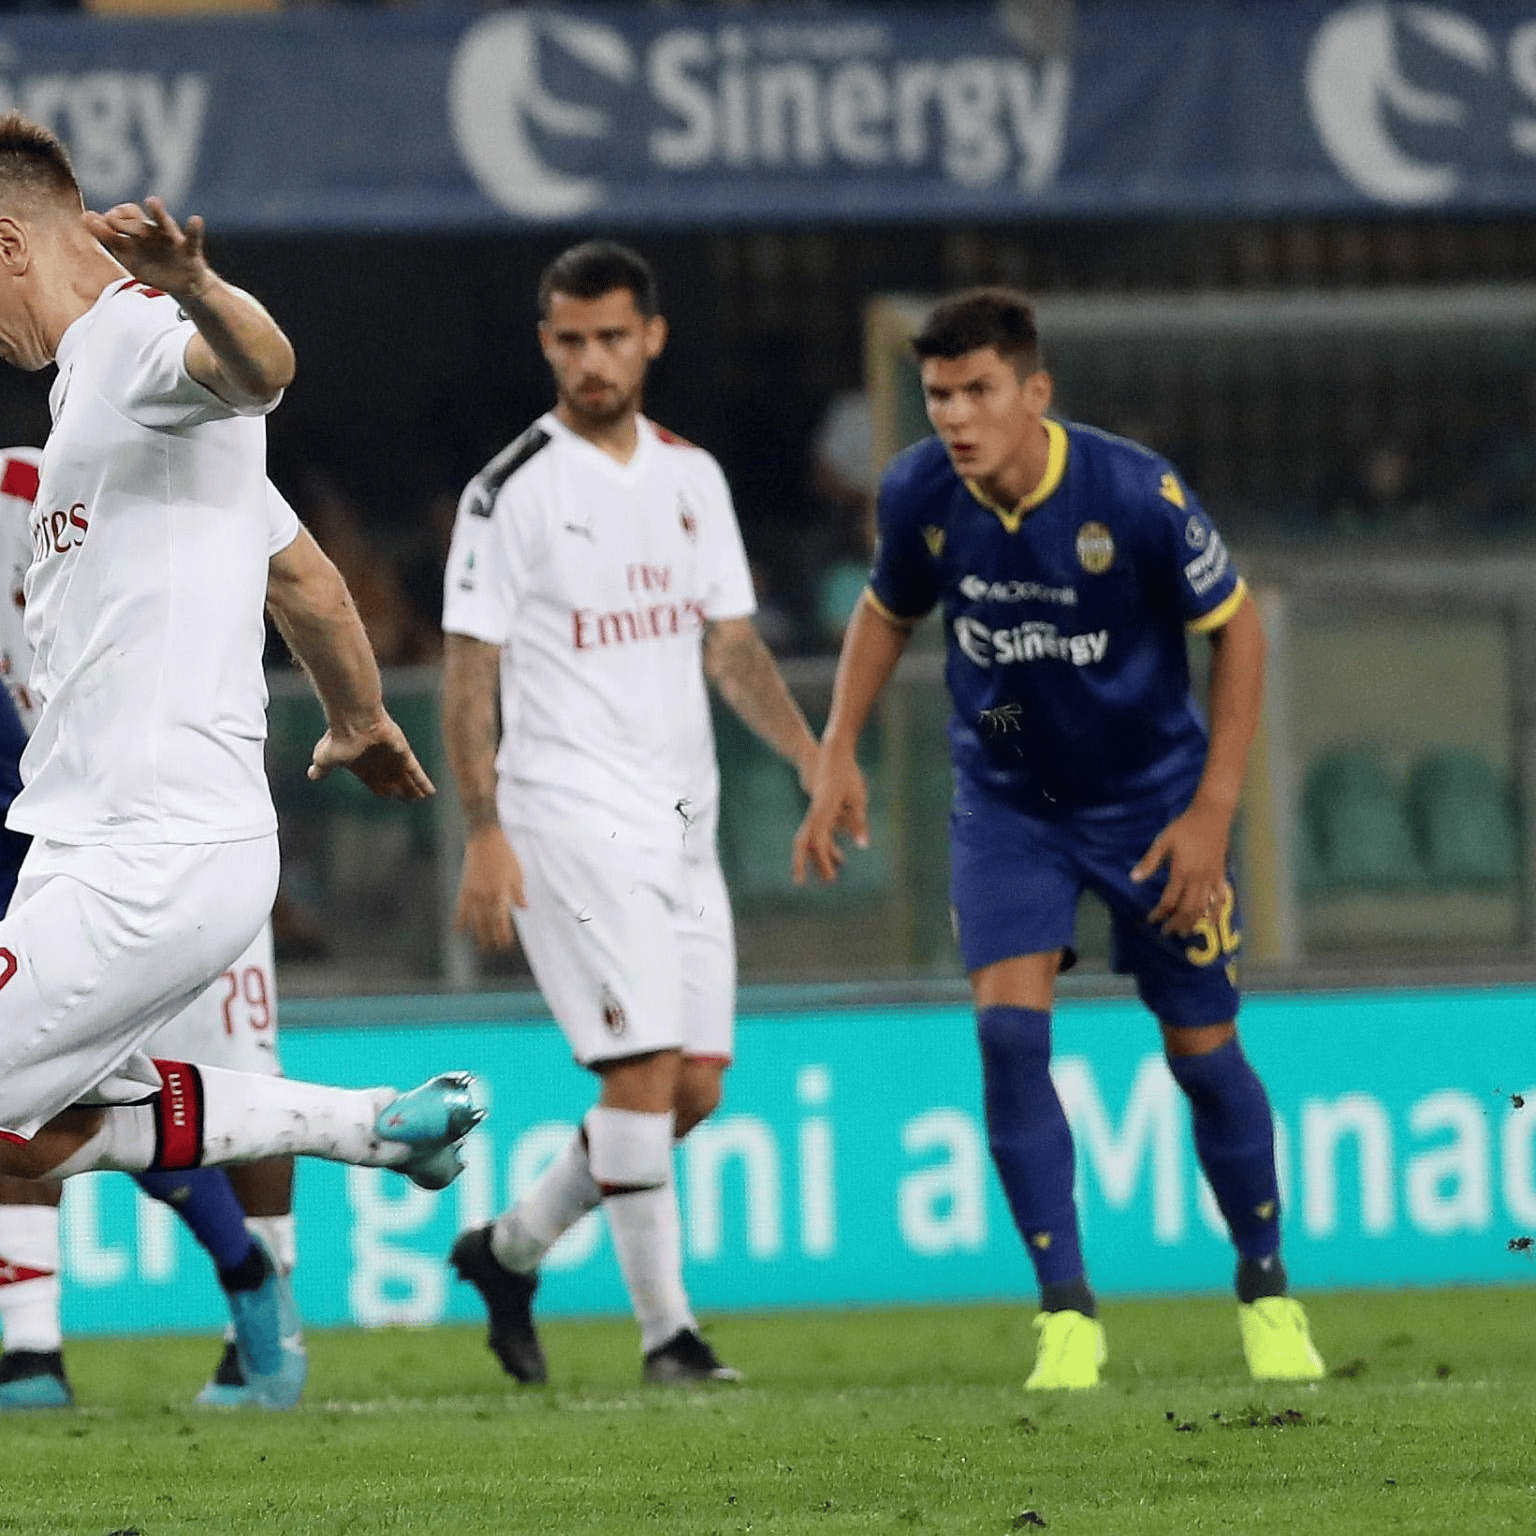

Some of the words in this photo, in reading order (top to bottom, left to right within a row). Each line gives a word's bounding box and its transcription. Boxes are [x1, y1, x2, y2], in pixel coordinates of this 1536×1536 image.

[648, 28, 1068, 190] Sinergy
[992, 627, 1109, 666] Sinergy
[220, 966, 269, 1035] 79
[898, 1107, 986, 1255] a
